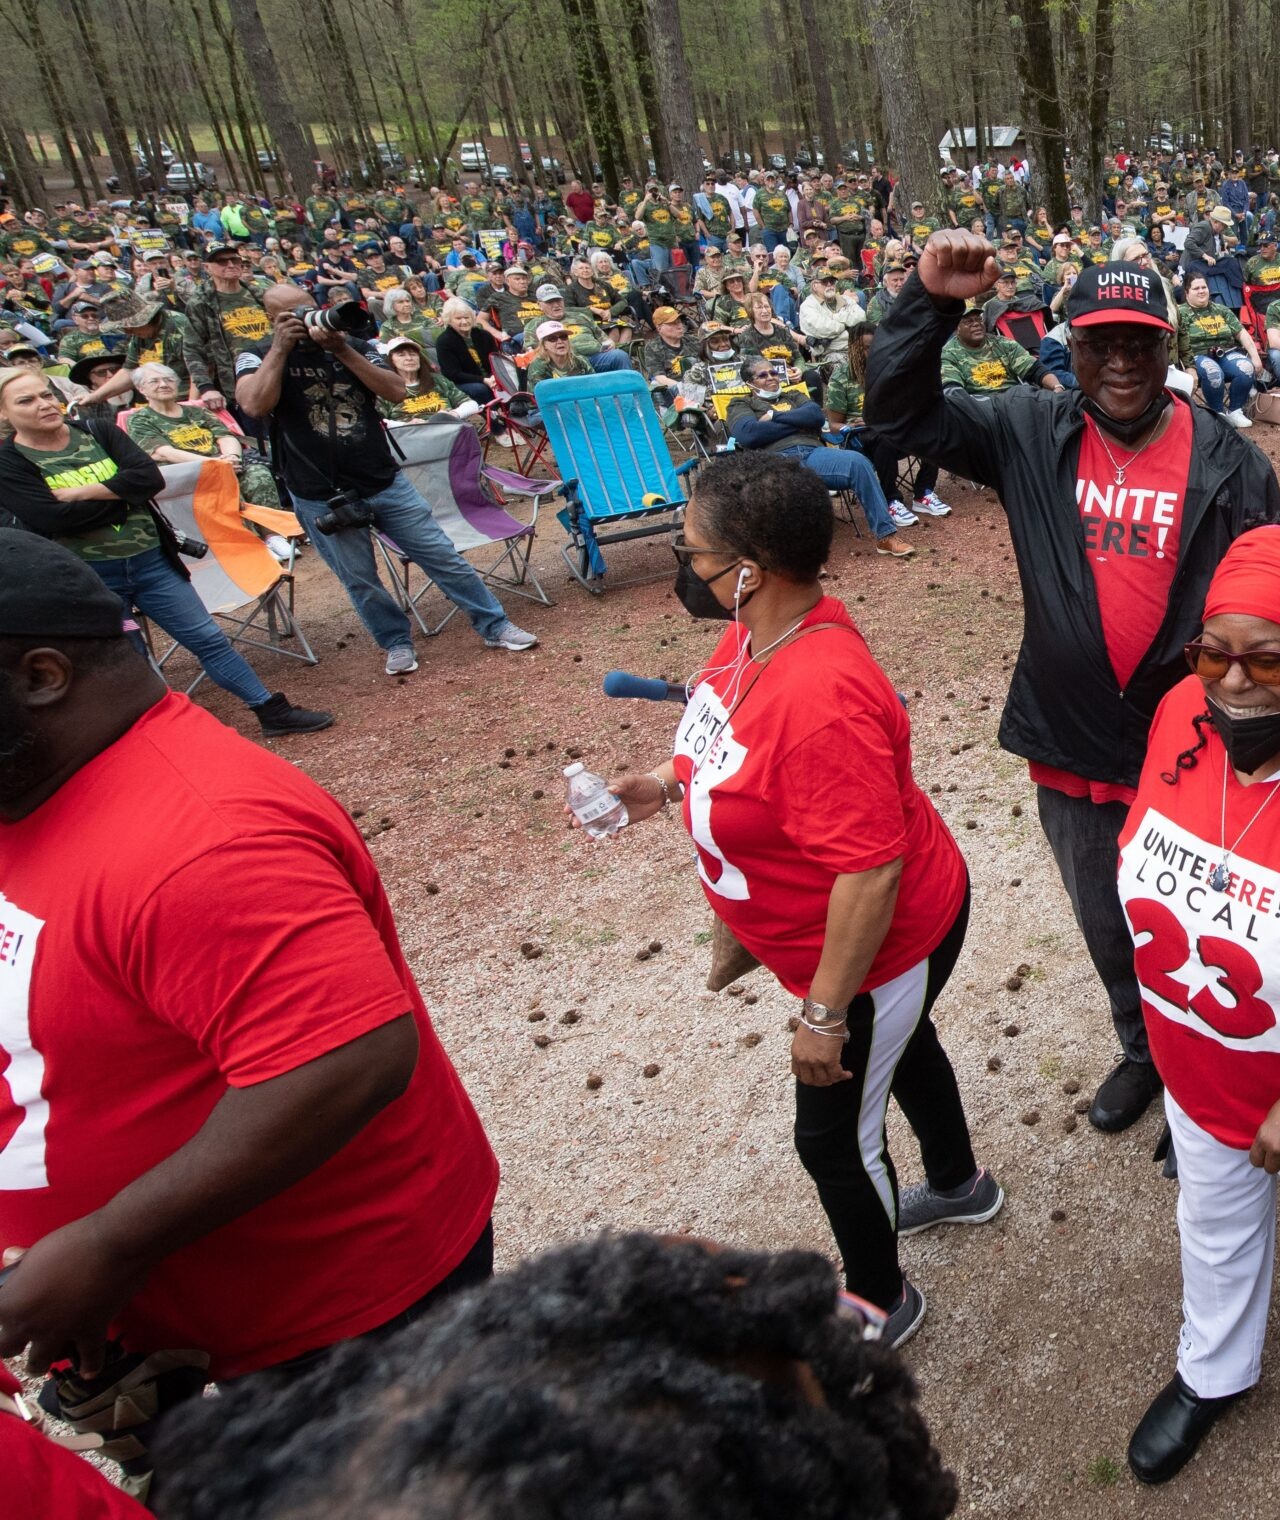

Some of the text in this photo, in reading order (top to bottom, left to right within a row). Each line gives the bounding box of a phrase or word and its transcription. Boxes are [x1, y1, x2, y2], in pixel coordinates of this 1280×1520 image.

[1097, 271, 1151, 289] UNITE
[1097, 285, 1150, 304] HERE!
[1081, 515, 1169, 559] ERE!
[1136, 858, 1258, 942] LOCAL
[1125, 897, 1277, 1039] 23
